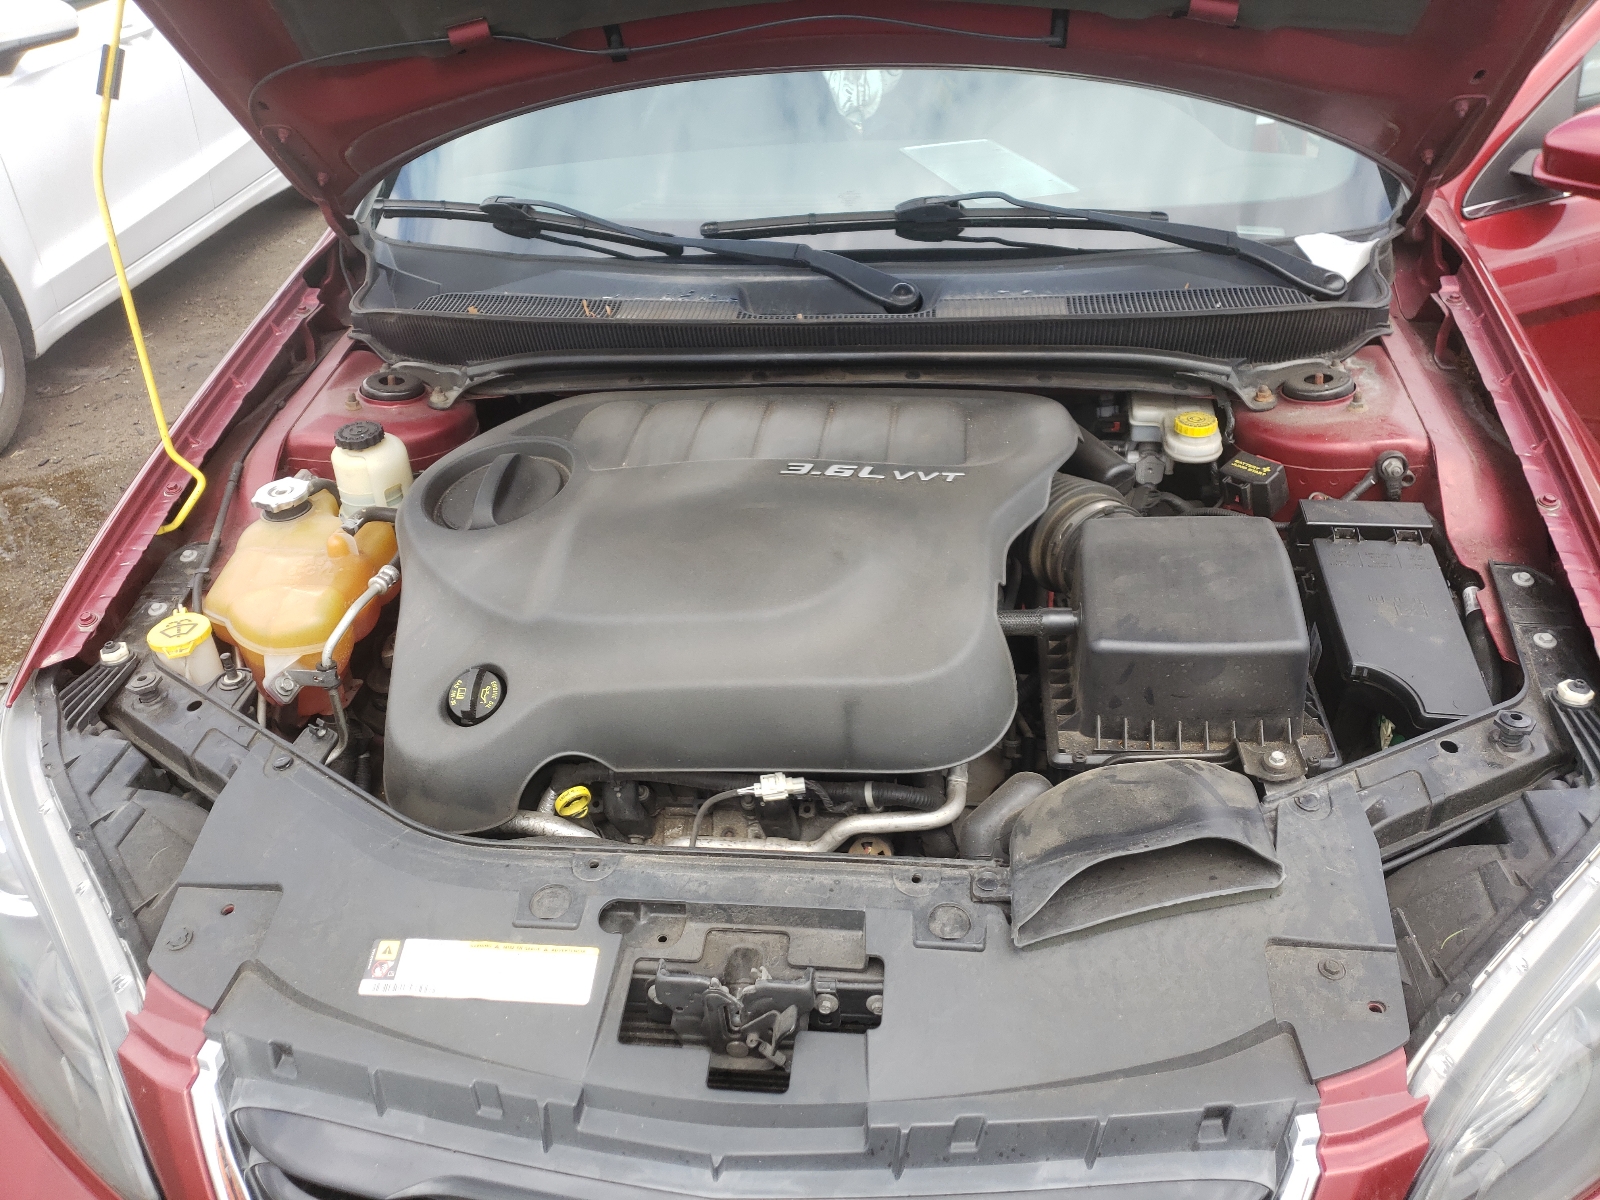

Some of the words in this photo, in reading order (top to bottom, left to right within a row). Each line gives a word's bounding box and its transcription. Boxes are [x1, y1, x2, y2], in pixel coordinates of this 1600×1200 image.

[779, 462, 886, 479] 3.6L
[892, 469, 966, 482] VVT
[1234, 459, 1260, 470] BATTERY
